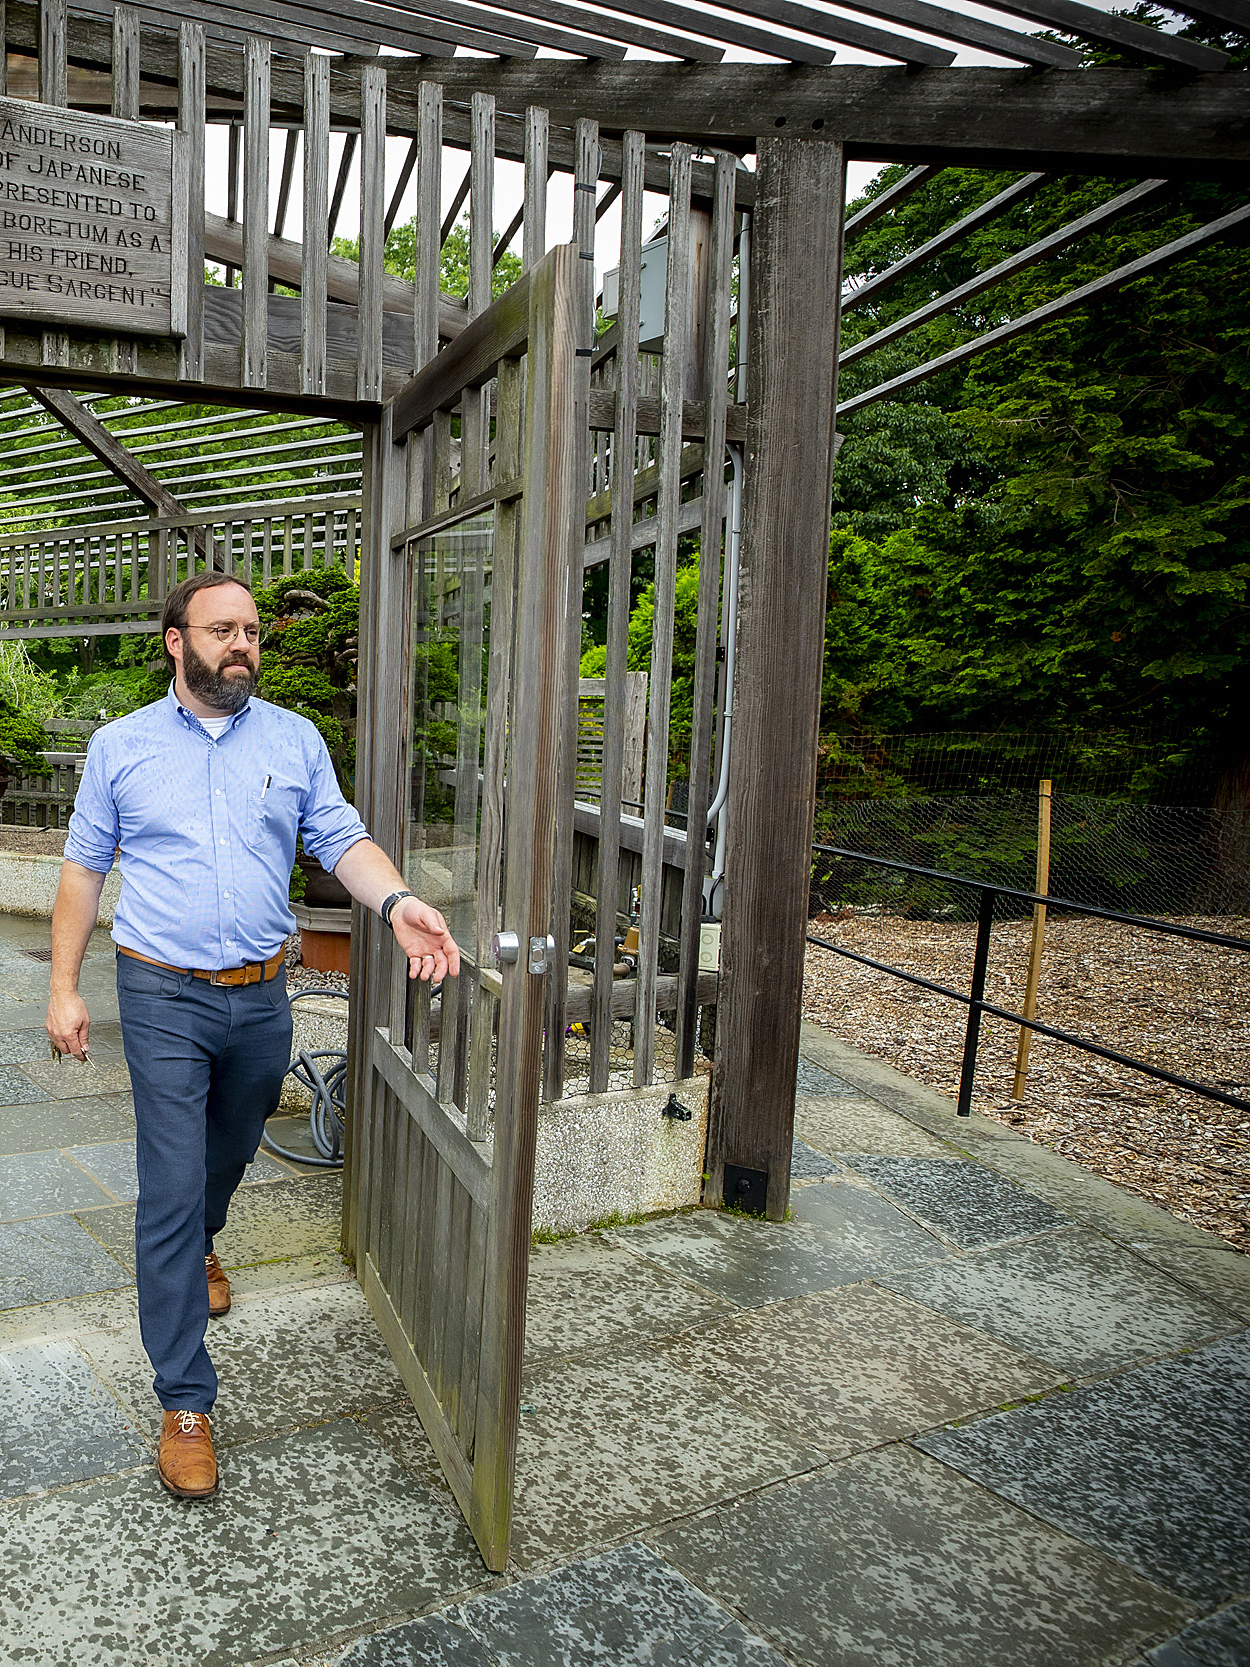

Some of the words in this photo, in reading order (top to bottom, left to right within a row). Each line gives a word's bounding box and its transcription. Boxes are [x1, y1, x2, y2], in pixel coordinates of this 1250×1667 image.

[1, 119, 121, 160] ANDERSON
[28, 155, 145, 191] JAPANESE
[129, 202, 156, 222] TO
[116, 229, 142, 248] AS
[150, 235, 162, 252] A
[9, 241, 42, 262] HIS
[51, 248, 133, 277] FRIEND,
